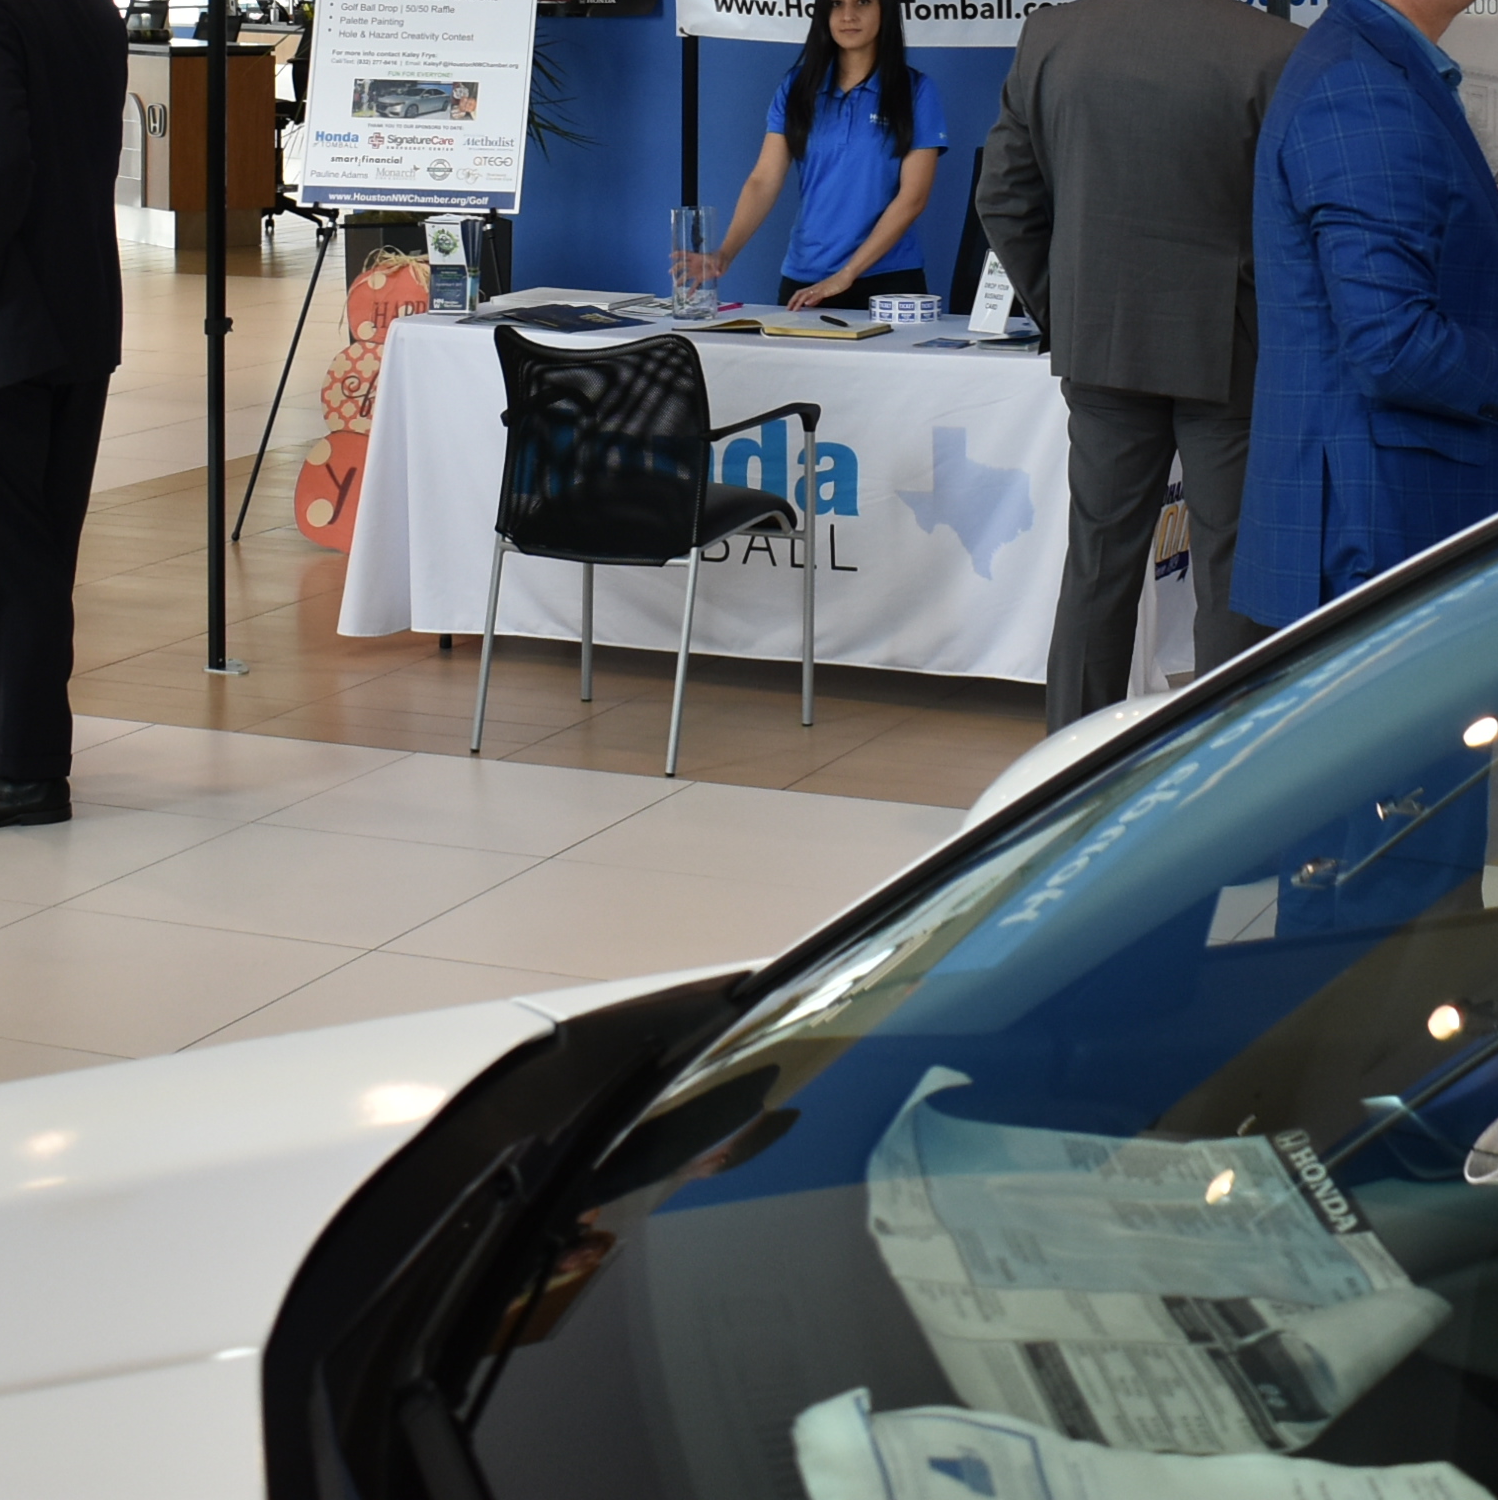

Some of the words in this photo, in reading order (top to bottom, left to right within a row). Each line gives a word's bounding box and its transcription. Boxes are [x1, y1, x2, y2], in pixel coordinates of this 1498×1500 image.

[341, 2, 359, 12] Golf
[360, 3, 376, 12] Ball
[378, 4, 398, 14] Drop
[405, 5, 429, 13] 50/50
[430, 5, 455, 14] Raffle
[339, 16, 369, 25] Palette
[371, 17, 404, 27] Painting
[338, 30, 358, 39] Hole
[360, 31, 366, 39] &
[368, 31, 399, 39] Hazard
[401, 31, 440, 41] Creativity
[441, 32, 474, 41] Contest
[315, 131, 359, 142] Honda
[387, 134, 454, 146] SignatureCare
[310, 170, 340, 178] Pauline
[341, 171, 368, 179] Adams
[1289, 1146, 1358, 1233] HONDA
